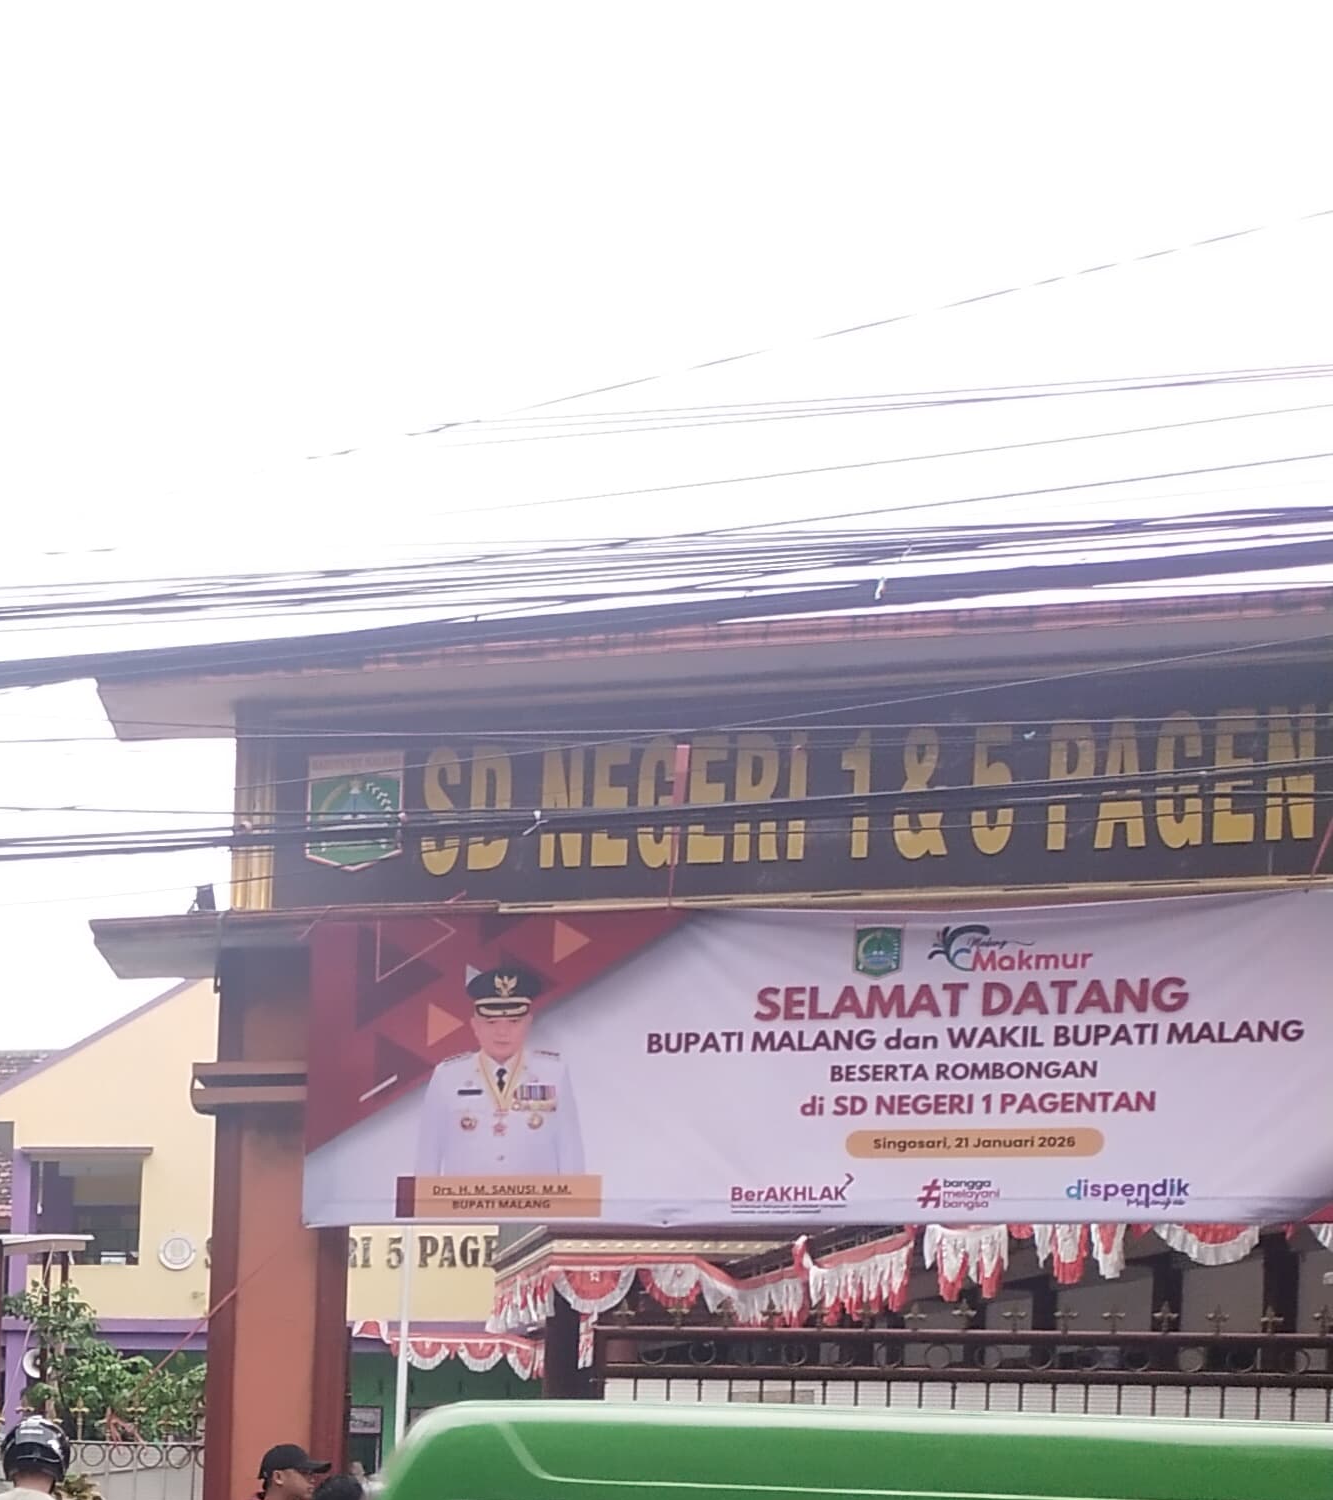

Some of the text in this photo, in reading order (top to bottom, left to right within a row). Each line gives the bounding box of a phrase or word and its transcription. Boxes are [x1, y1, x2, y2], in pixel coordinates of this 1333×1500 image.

[420, 744, 513, 876] SD
[539, 731, 808, 869] NEGERI
[842, 729, 870, 859] 1
[893, 727, 947, 860] &
[971, 725, 1013, 855] 5
[972, 949, 1093, 971] Makmur
[754, 977, 1189, 1021] SELAMAT DATANG
[647, 1019, 1305, 1053] BUPATI MALANG dan WAKIL BUPATI MALANG
[830, 1060, 1098, 1082] BESERTA ROMBONGAN
[800, 1091, 1156, 1116] di SD NEGERI 1 PAGENTAN
[874, 1136, 1076, 1152] Singosari, 21 Januari 2026
[731, 1181, 851, 1201] BerAKHLAK
[943, 1178, 992, 1191] bangga
[1065, 1178, 1189, 1204] dispendik
[452, 1199, 550, 1209] BUPATI MALANG
[942, 1198, 989, 1211] bangsa
[387, 1236, 404, 1269] 5
